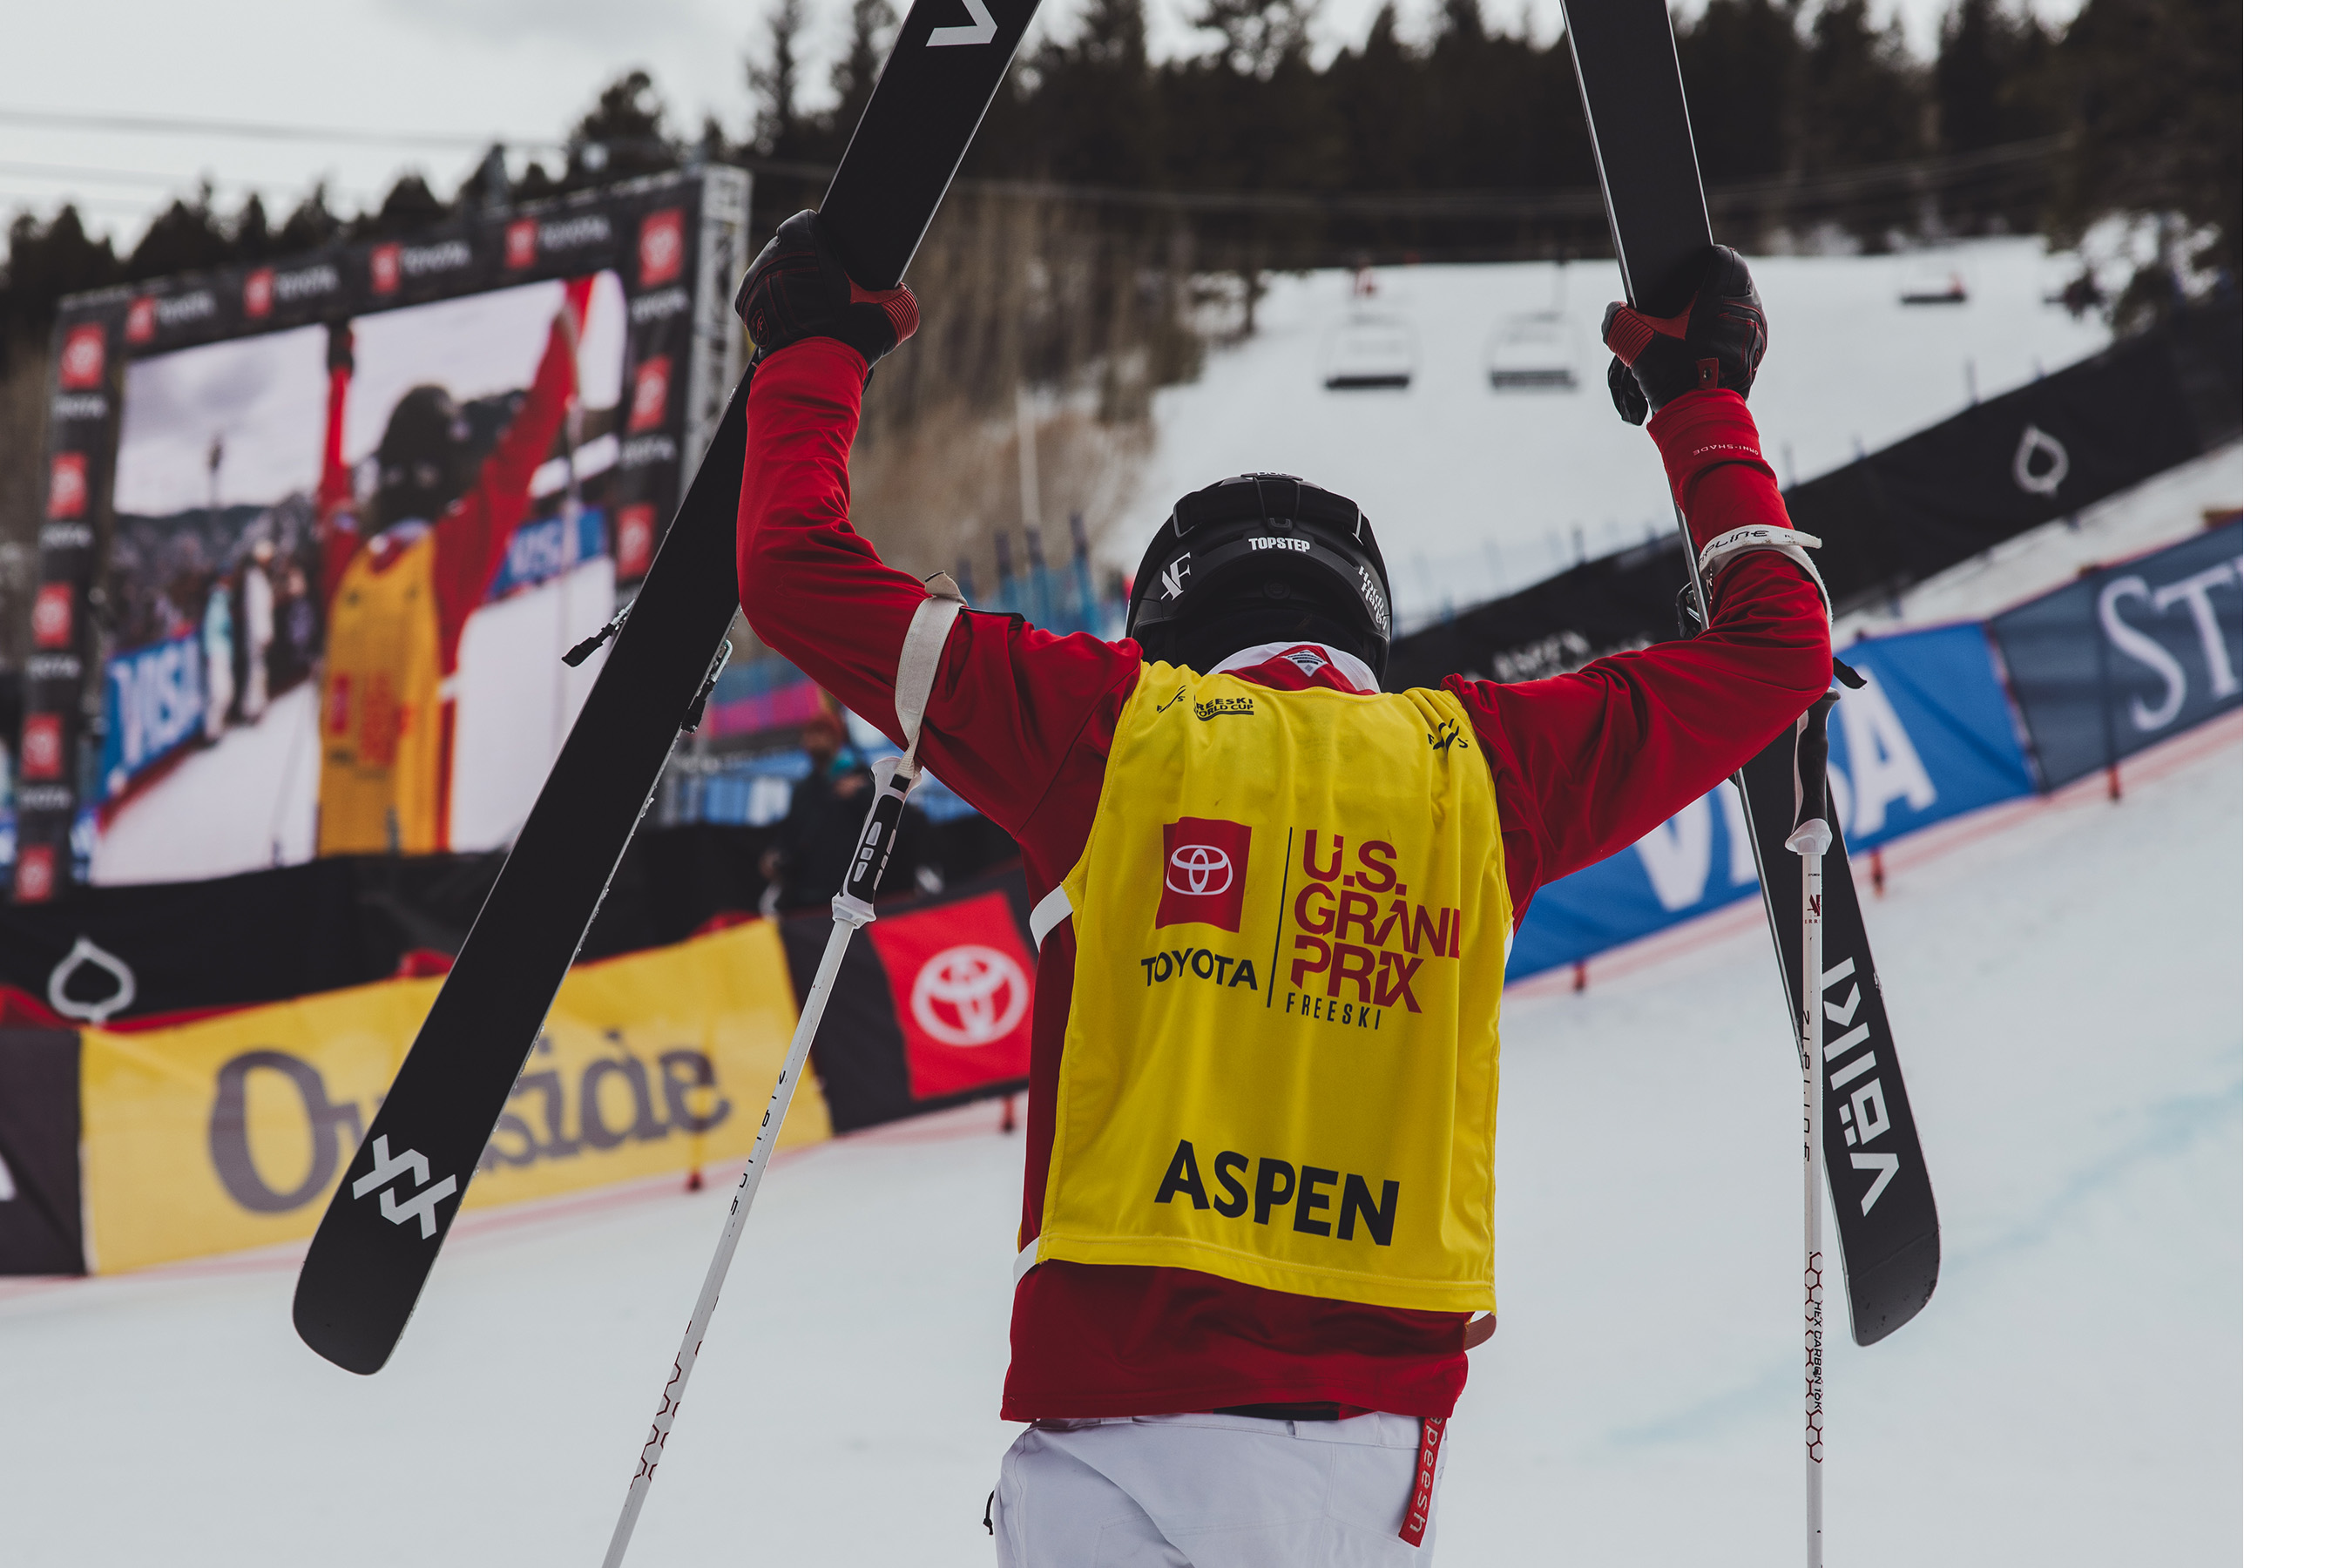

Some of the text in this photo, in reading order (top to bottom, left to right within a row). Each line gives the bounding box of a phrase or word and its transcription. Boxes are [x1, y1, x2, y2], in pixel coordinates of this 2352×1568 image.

[1693, 443, 1759, 456] OMNI-SHADE
[1248, 537, 1311, 553] TOPSTEP
[2099, 553, 2243, 732] ST
[1194, 696, 1254, 711] REESKI
[1302, 828, 1408, 897] U.S.
[1140, 947, 1259, 992] TOYOTA
[1290, 934, 1425, 1015] PRIX
[1285, 991, 1382, 1031] FREESKI
[1153, 1138, 1401, 1247] ASPEN
[1814, 1301, 1823, 1327] HEX
[1813, 1330, 1823, 1385] CARBON
